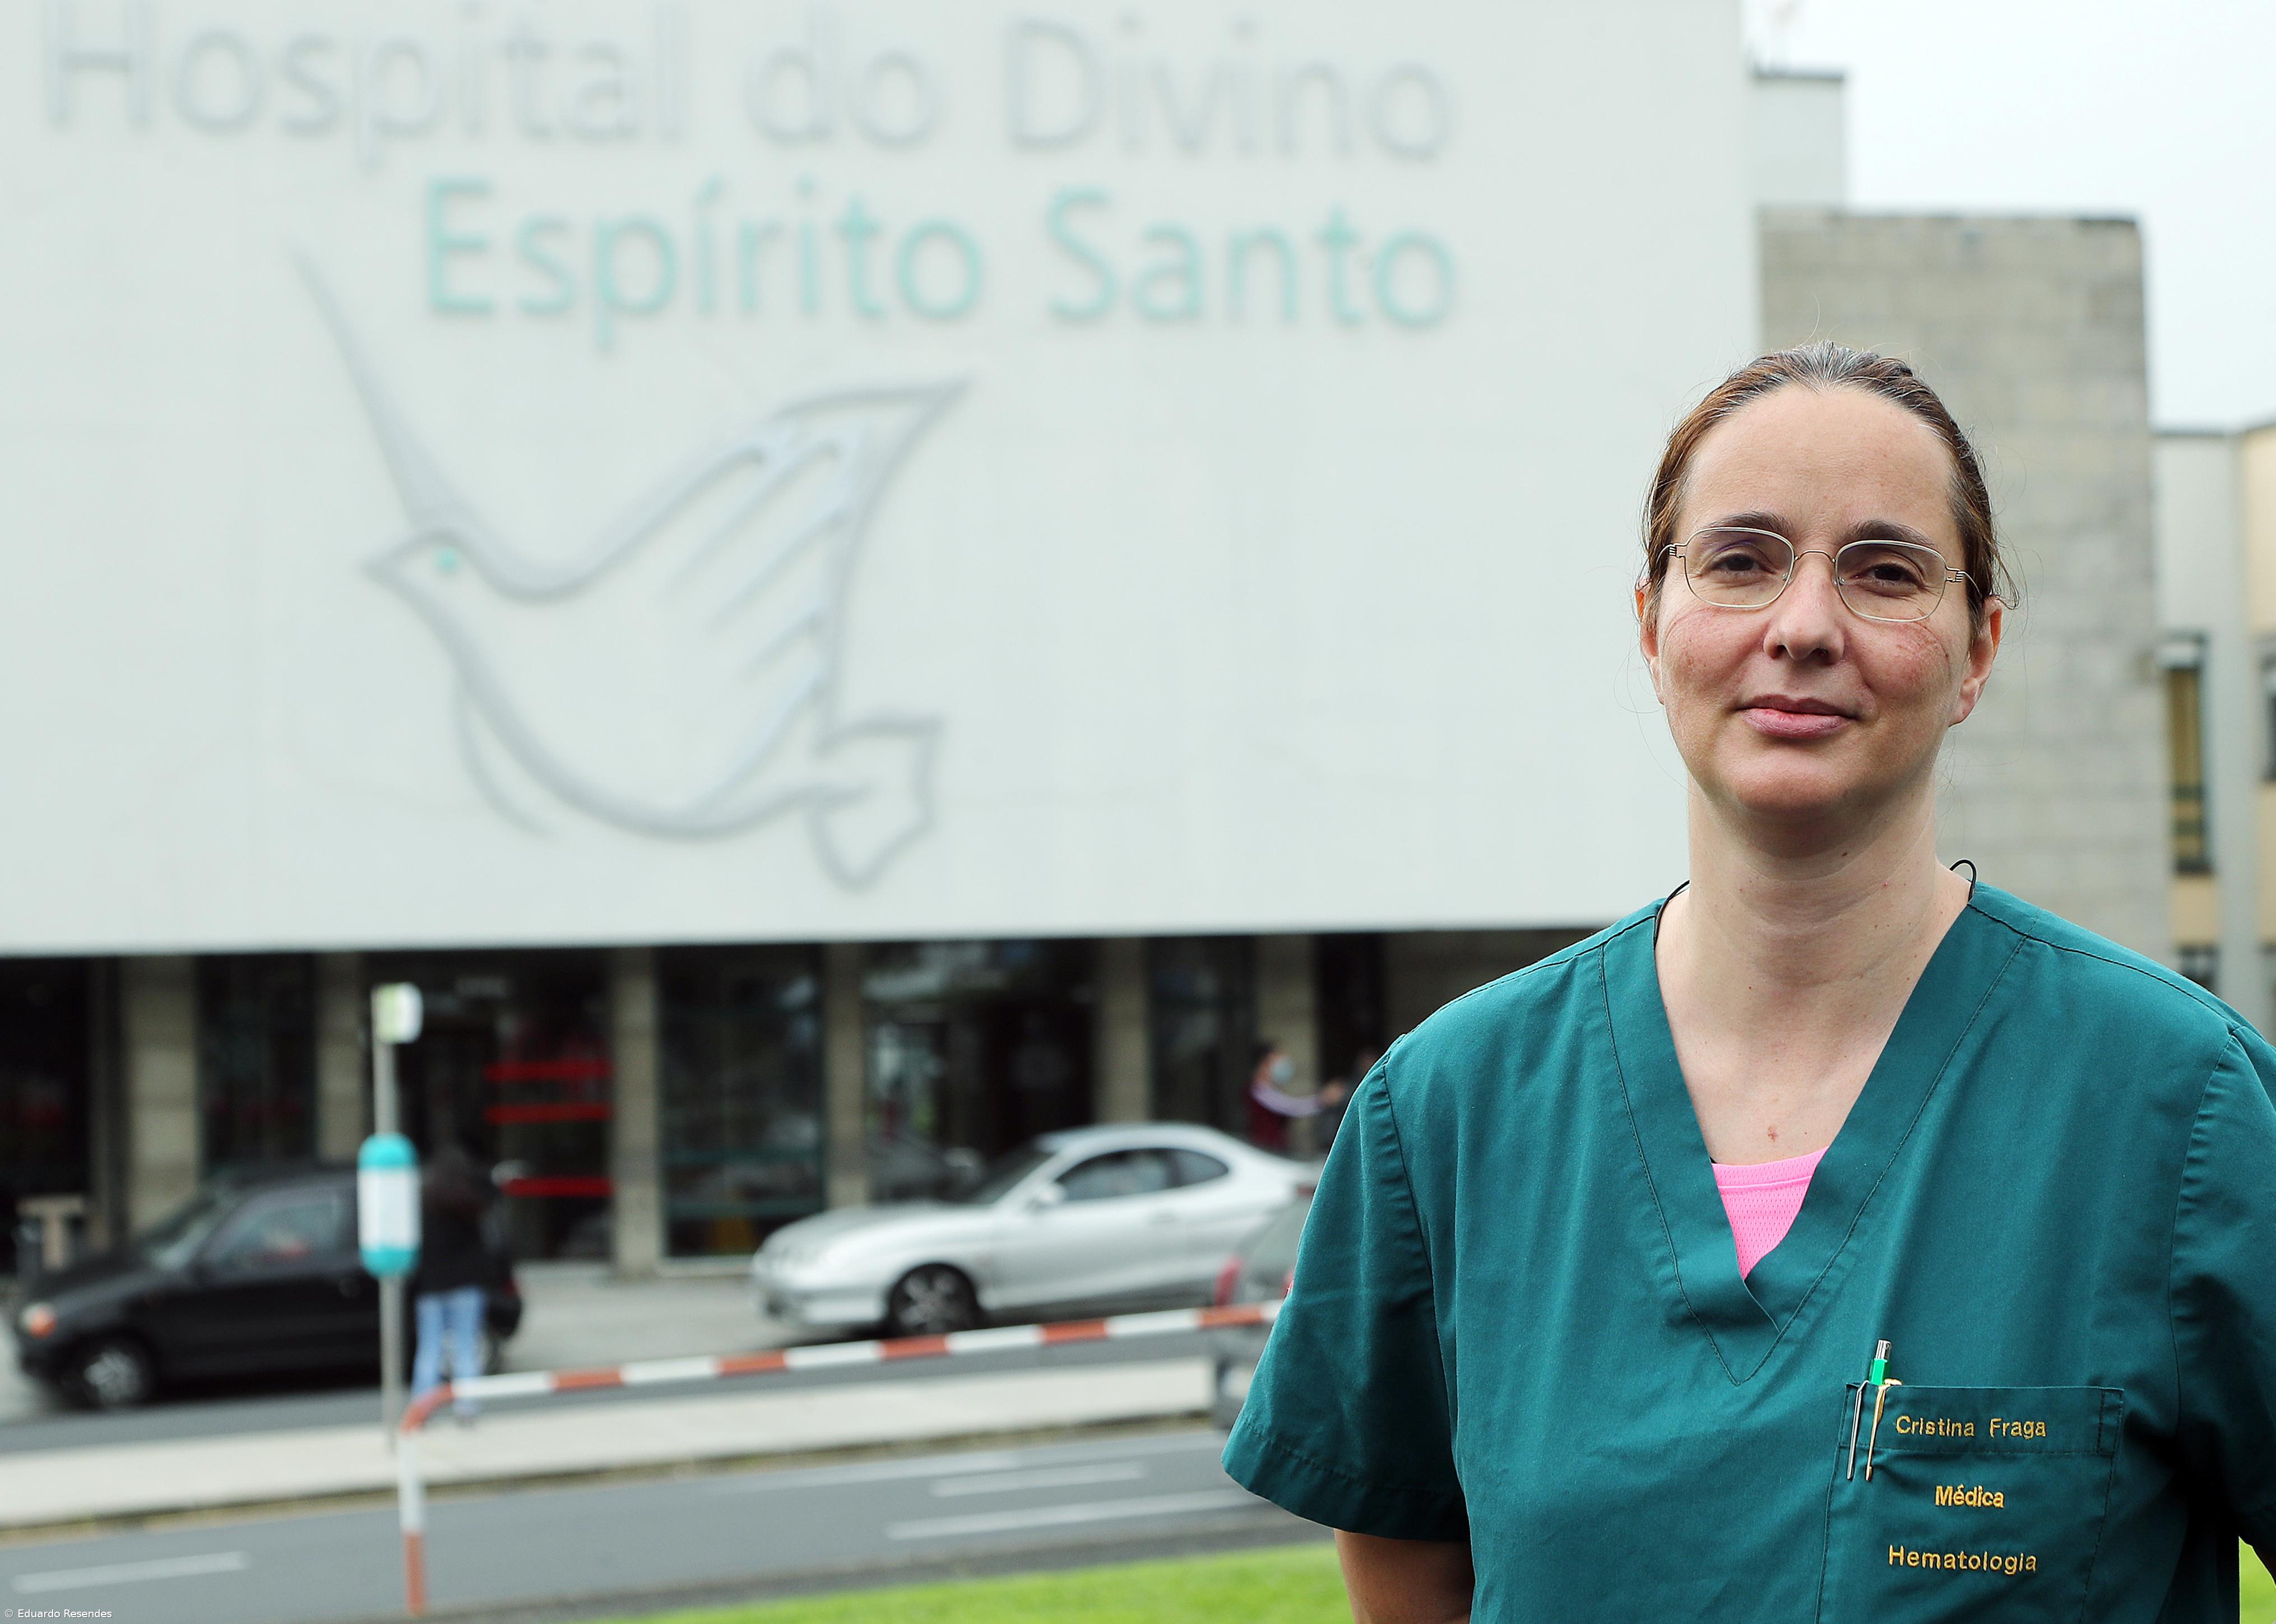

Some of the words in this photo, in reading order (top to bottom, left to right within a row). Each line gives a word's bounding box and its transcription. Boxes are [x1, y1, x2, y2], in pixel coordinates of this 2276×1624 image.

[45, 0, 685, 173] Hospital
[748, 2, 942, 150] do
[1007, 14, 1452, 163] Divino
[426, 175, 984, 353] Espírito
[1047, 185, 1457, 331] Santo
[1896, 1416, 1974, 1436] Cristina
[1990, 1418, 2046, 1439] Fraga
[1935, 1484, 2004, 1507] Médica
[1888, 1545, 2037, 1575] Hematologia
